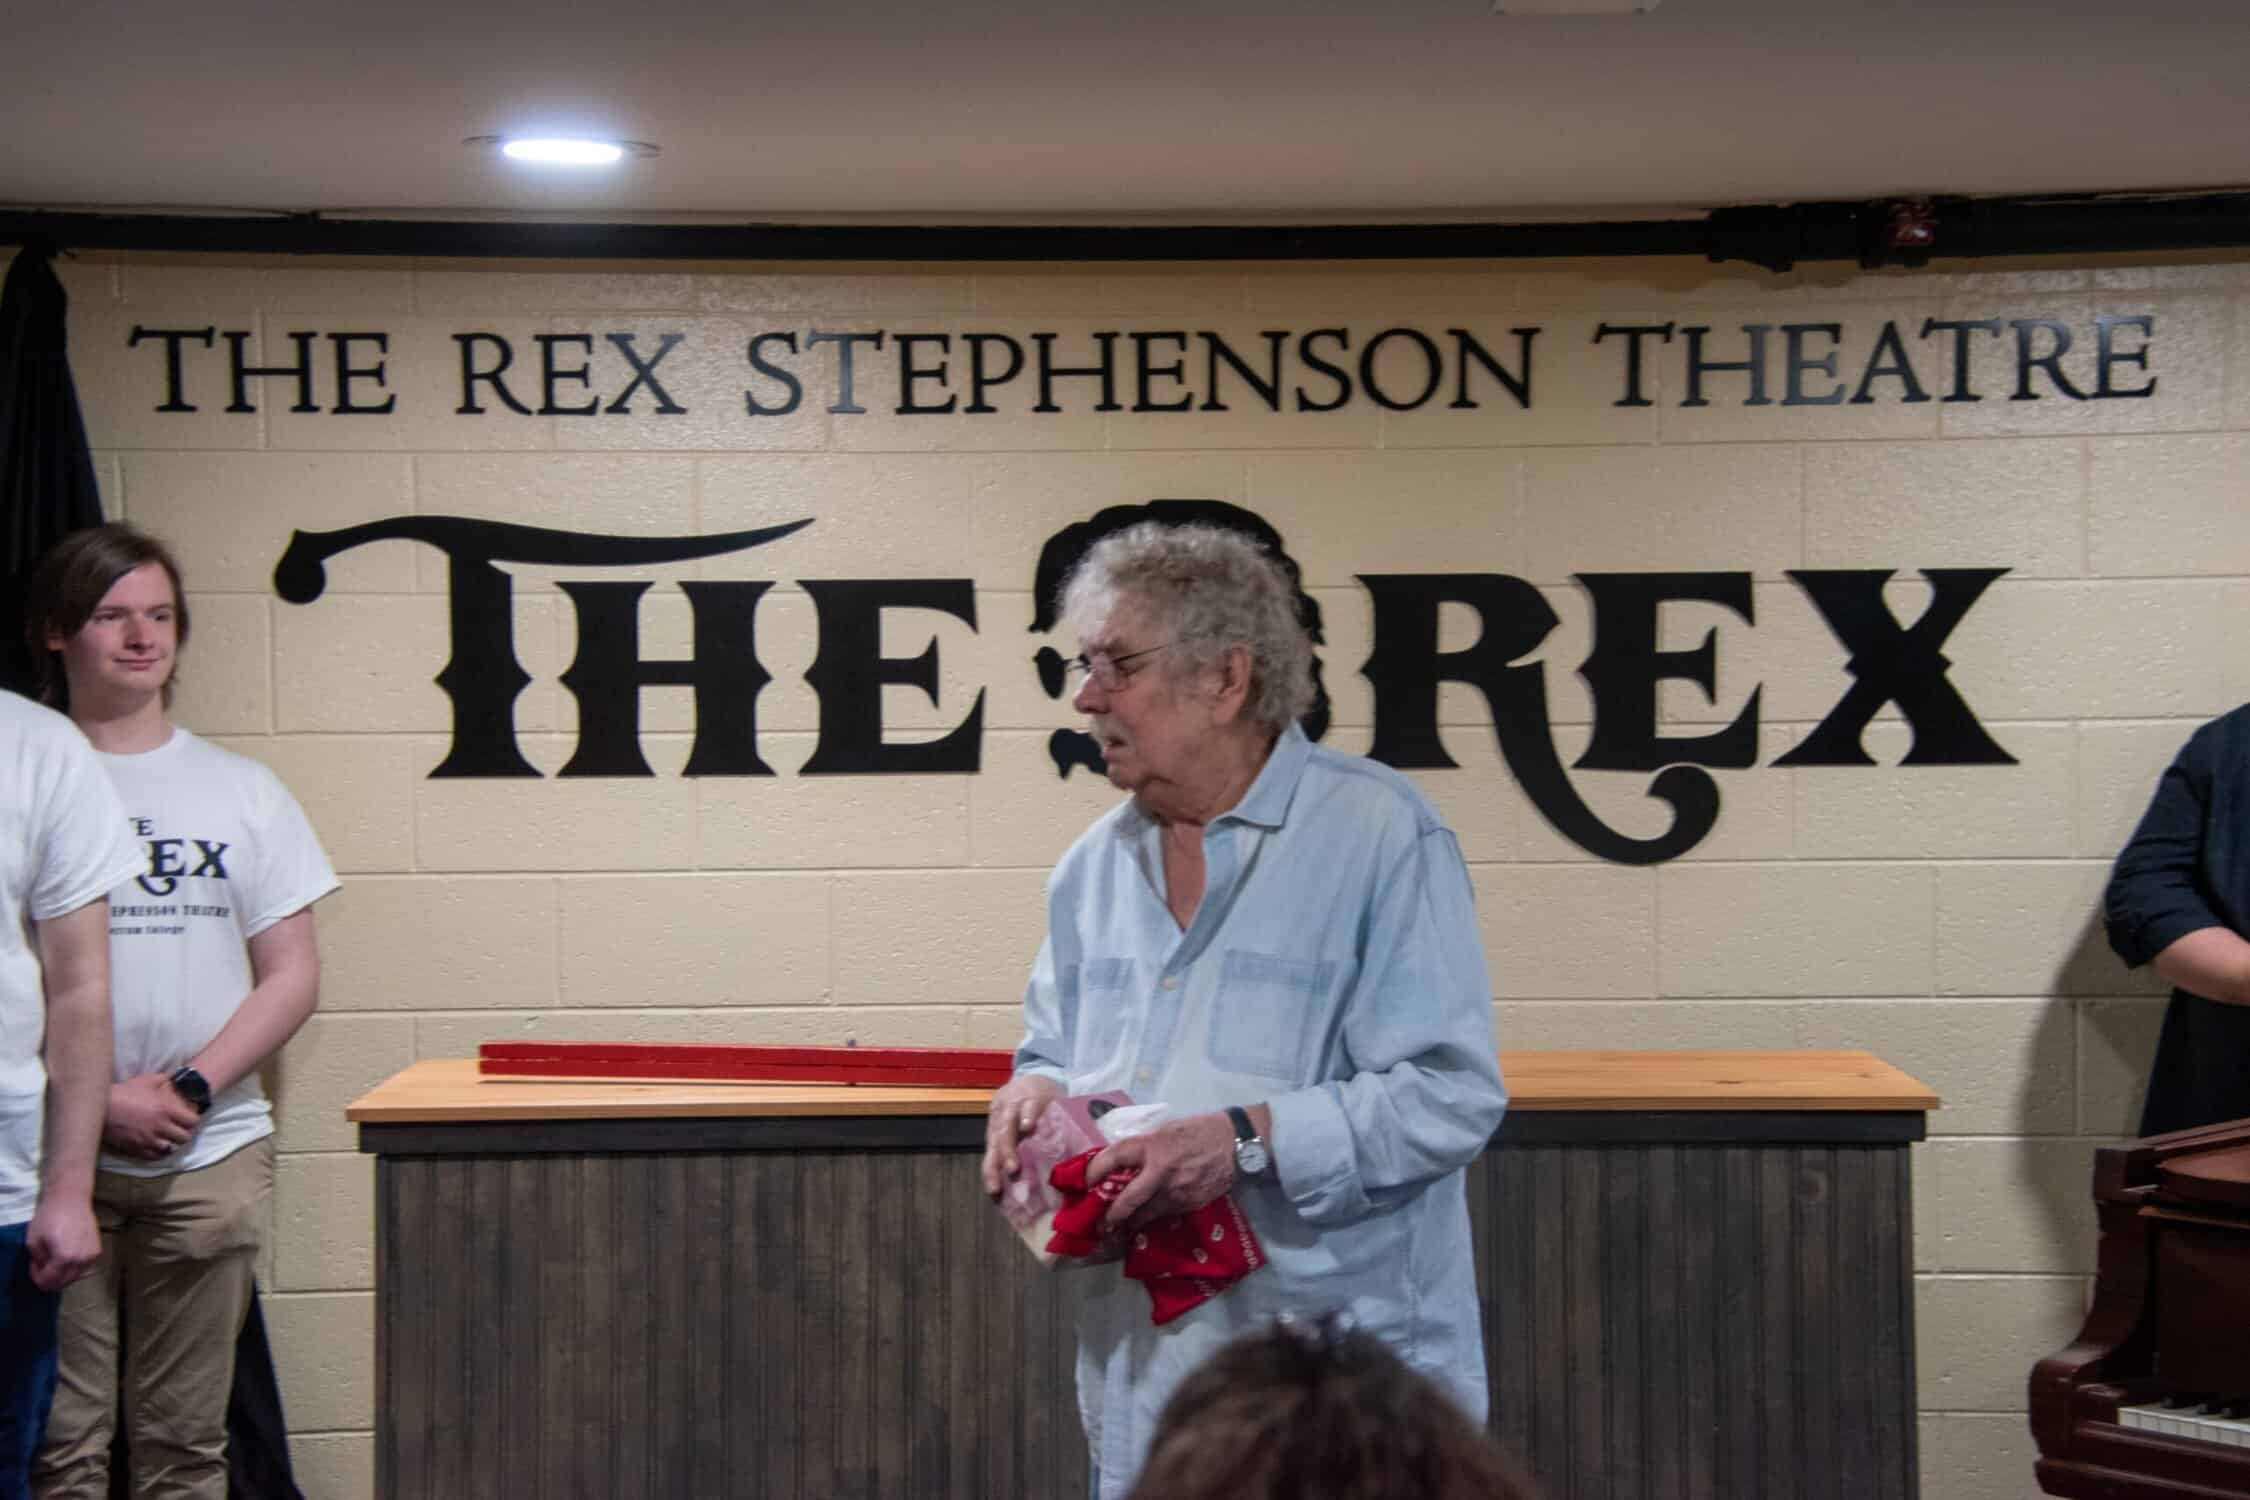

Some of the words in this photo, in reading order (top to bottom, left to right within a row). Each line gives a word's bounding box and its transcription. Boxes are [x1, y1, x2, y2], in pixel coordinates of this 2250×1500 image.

[128, 325, 396, 415] THE
[451, 331, 687, 416] REX
[745, 327, 1541, 416] STEPHENSON
[1593, 314, 2158, 407] THEATRE
[1355, 568, 2019, 866] REX
